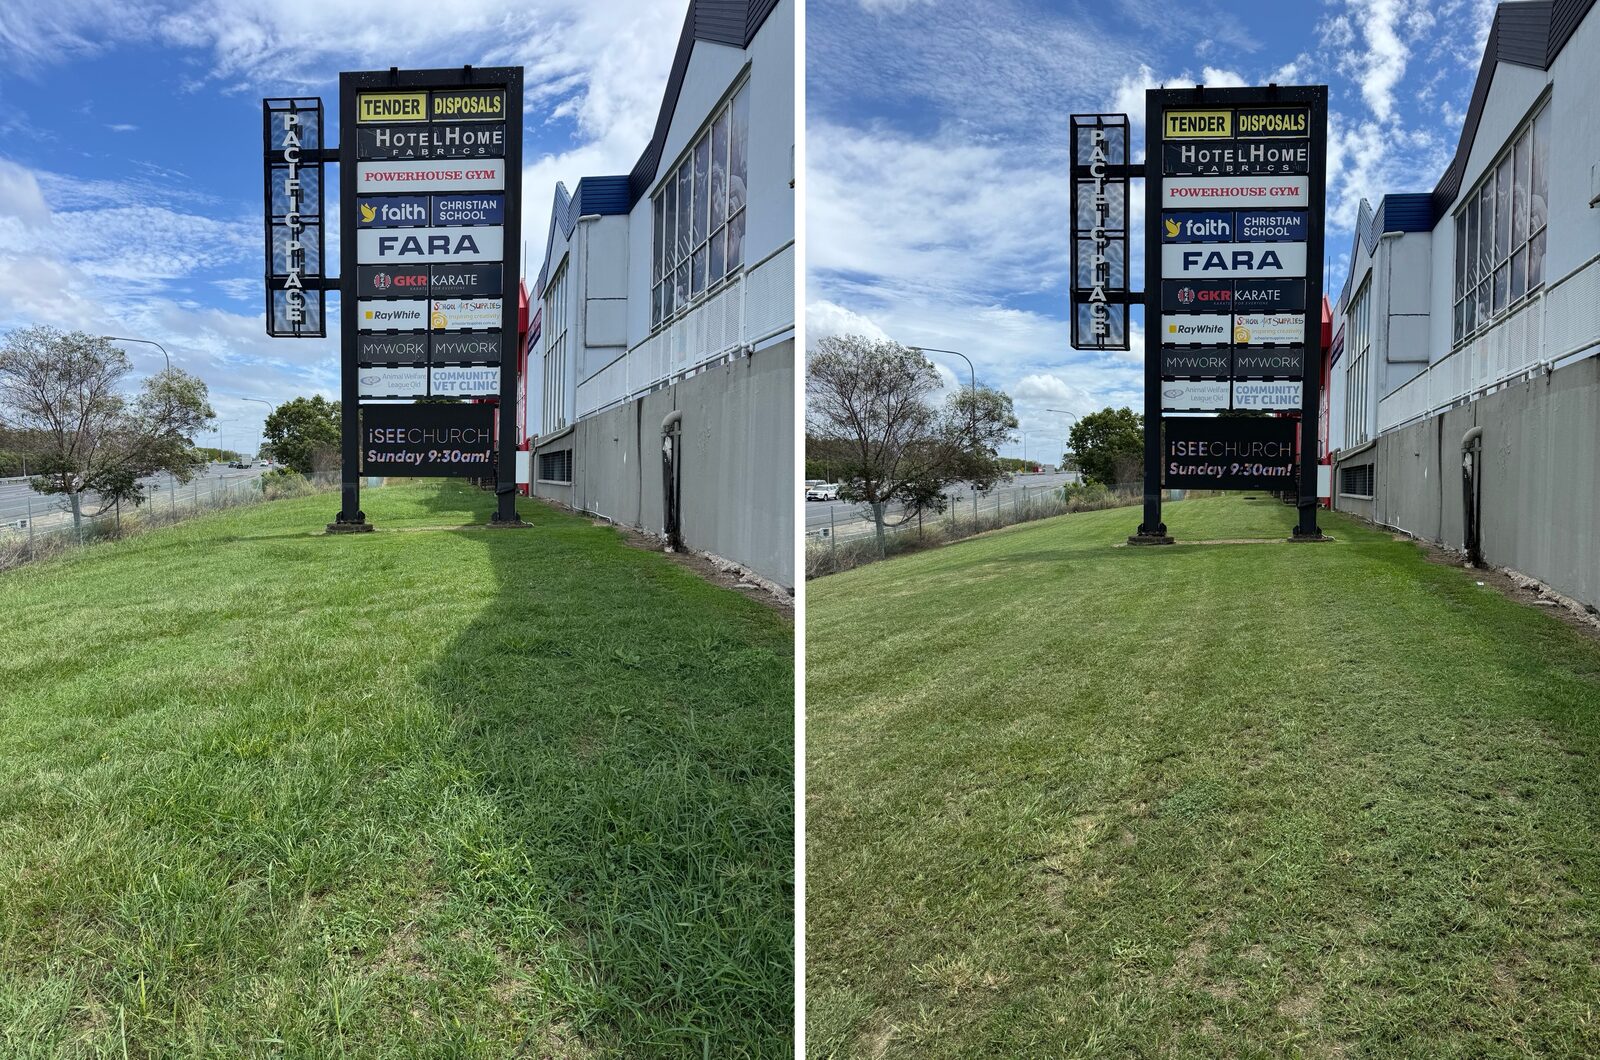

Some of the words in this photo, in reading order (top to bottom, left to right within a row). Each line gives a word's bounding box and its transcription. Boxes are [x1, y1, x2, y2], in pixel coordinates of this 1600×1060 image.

[364, 99, 420, 116] TENDER
[434, 95, 501, 114] DISPOSALS
[1170, 116, 1225, 132] TENDER
[1239, 114, 1305, 132] DISPOSALS
[393, 147, 485, 156] FABRICS
[282, 114, 301, 228] PACIFIC
[1198, 164, 1289, 172] FABRICS
[365, 171, 462, 182] POWERHOUSE
[465, 170, 496, 180] GYM
[1088, 130, 1106, 242] PACIFIC
[1170, 188, 1266, 197] POWERHOUSE
[1269, 187, 1300, 196] GYM
[439, 200, 497, 210] CHRISTIAN
[382, 203, 426, 221] faith
[439, 210, 486, 221] SCHOOL
[1243, 217, 1300, 226] CHRISTIAN
[1186, 219, 1230, 236] faith
[1243, 227, 1290, 236] SCHOOL
[379, 234, 480, 256] FARA
[1183, 250, 1284, 270] FARA
[283, 240, 302, 321] PLACE
[393, 275, 428, 287] GKR
[431, 274, 478, 285] KARATE
[1088, 254, 1107, 334] PLACE
[1197, 290, 1231, 301] GKR
[1234, 289, 1281, 300] KARATE
[363, 343, 424, 354] MYWORK
[436, 342, 498, 353] MYWORK
[1166, 357, 1227, 368] MYWORK
[1238, 357, 1300, 367] MYWORK
[433, 371, 498, 381] COMMUNITY
[388, 381, 410, 389] League
[433, 382, 456, 391] VET
[459, 380, 498, 391] CLINIC
[1236, 385, 1300, 395] COMMUNITY
[1236, 395, 1259, 404] VET
[1261, 395, 1300, 404] CLINIC
[367, 450, 425, 465] Sunday
[428, 449, 490, 463] 9:30am!
[1169, 462, 1227, 478] Sunday
[1230, 463, 1292, 476] 9:30am!
